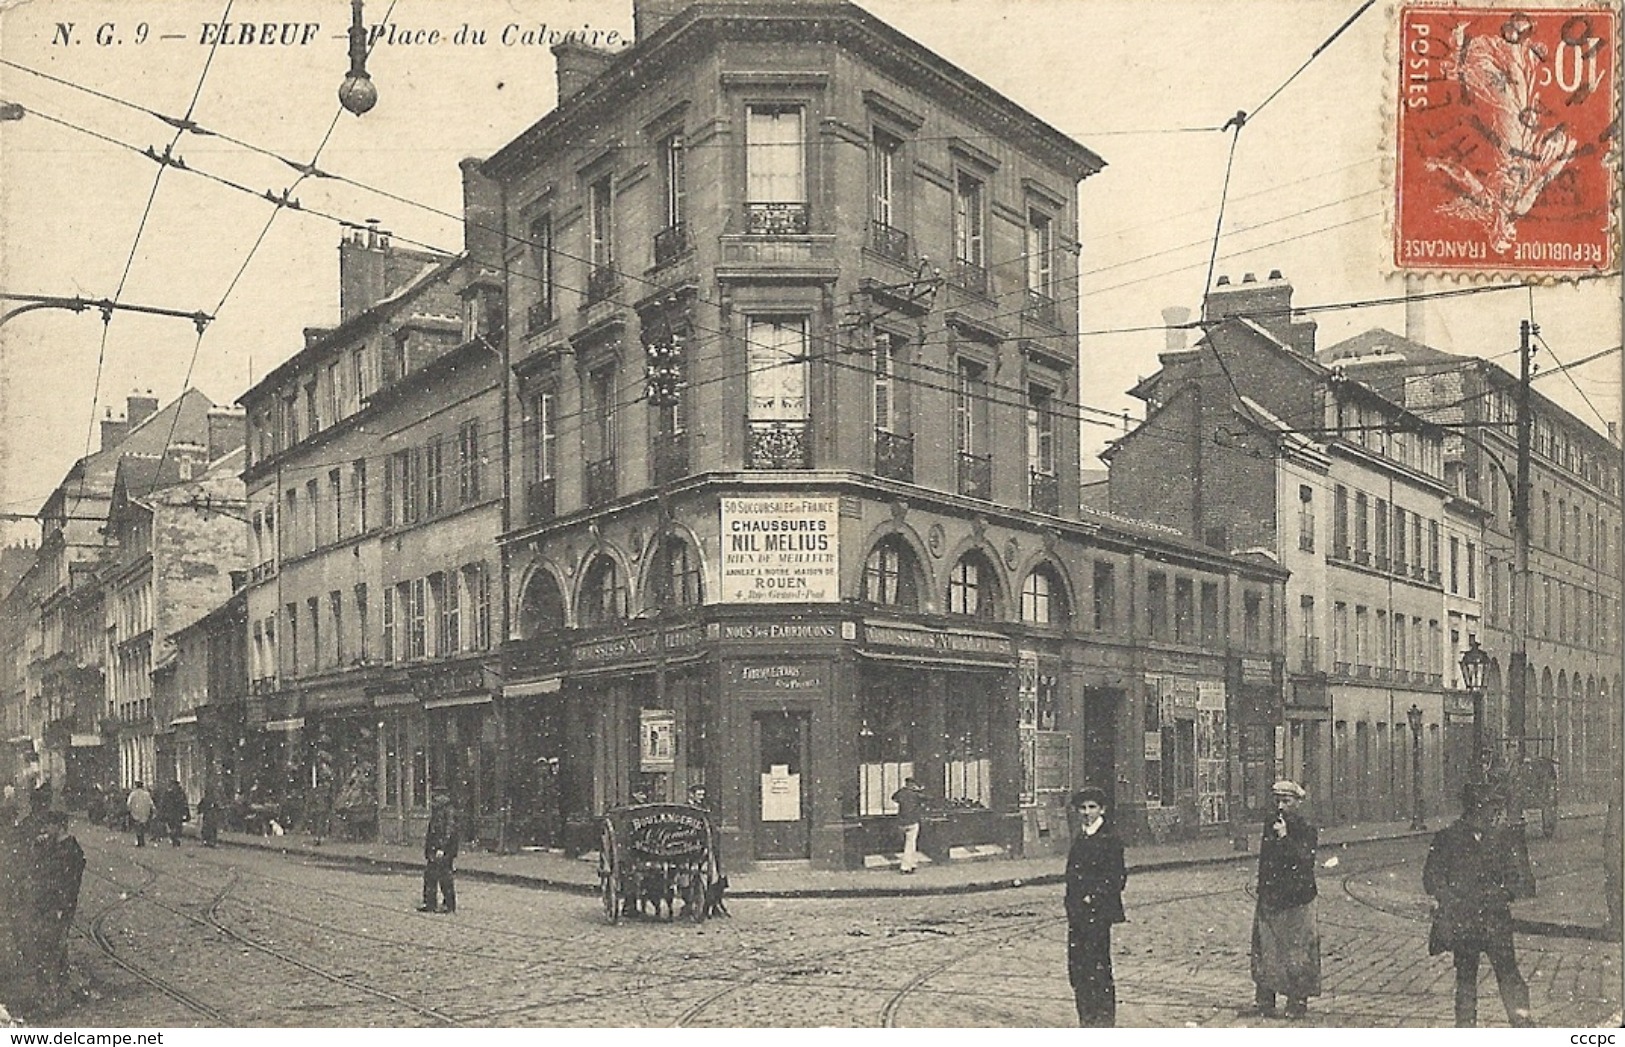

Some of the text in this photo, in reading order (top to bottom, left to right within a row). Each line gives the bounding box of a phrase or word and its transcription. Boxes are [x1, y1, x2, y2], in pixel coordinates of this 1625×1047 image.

[1408, 22, 1430, 109] POSTES
[802, 500, 834, 514] FRANCE
[731, 520, 827, 532] CHAUSSURES
[732, 534, 829, 552] NIL MELIUS
[755, 578, 808, 589] ROUEN
[724, 626, 751, 639] NOUS
[631, 813, 703, 831] BOULANGERIE
